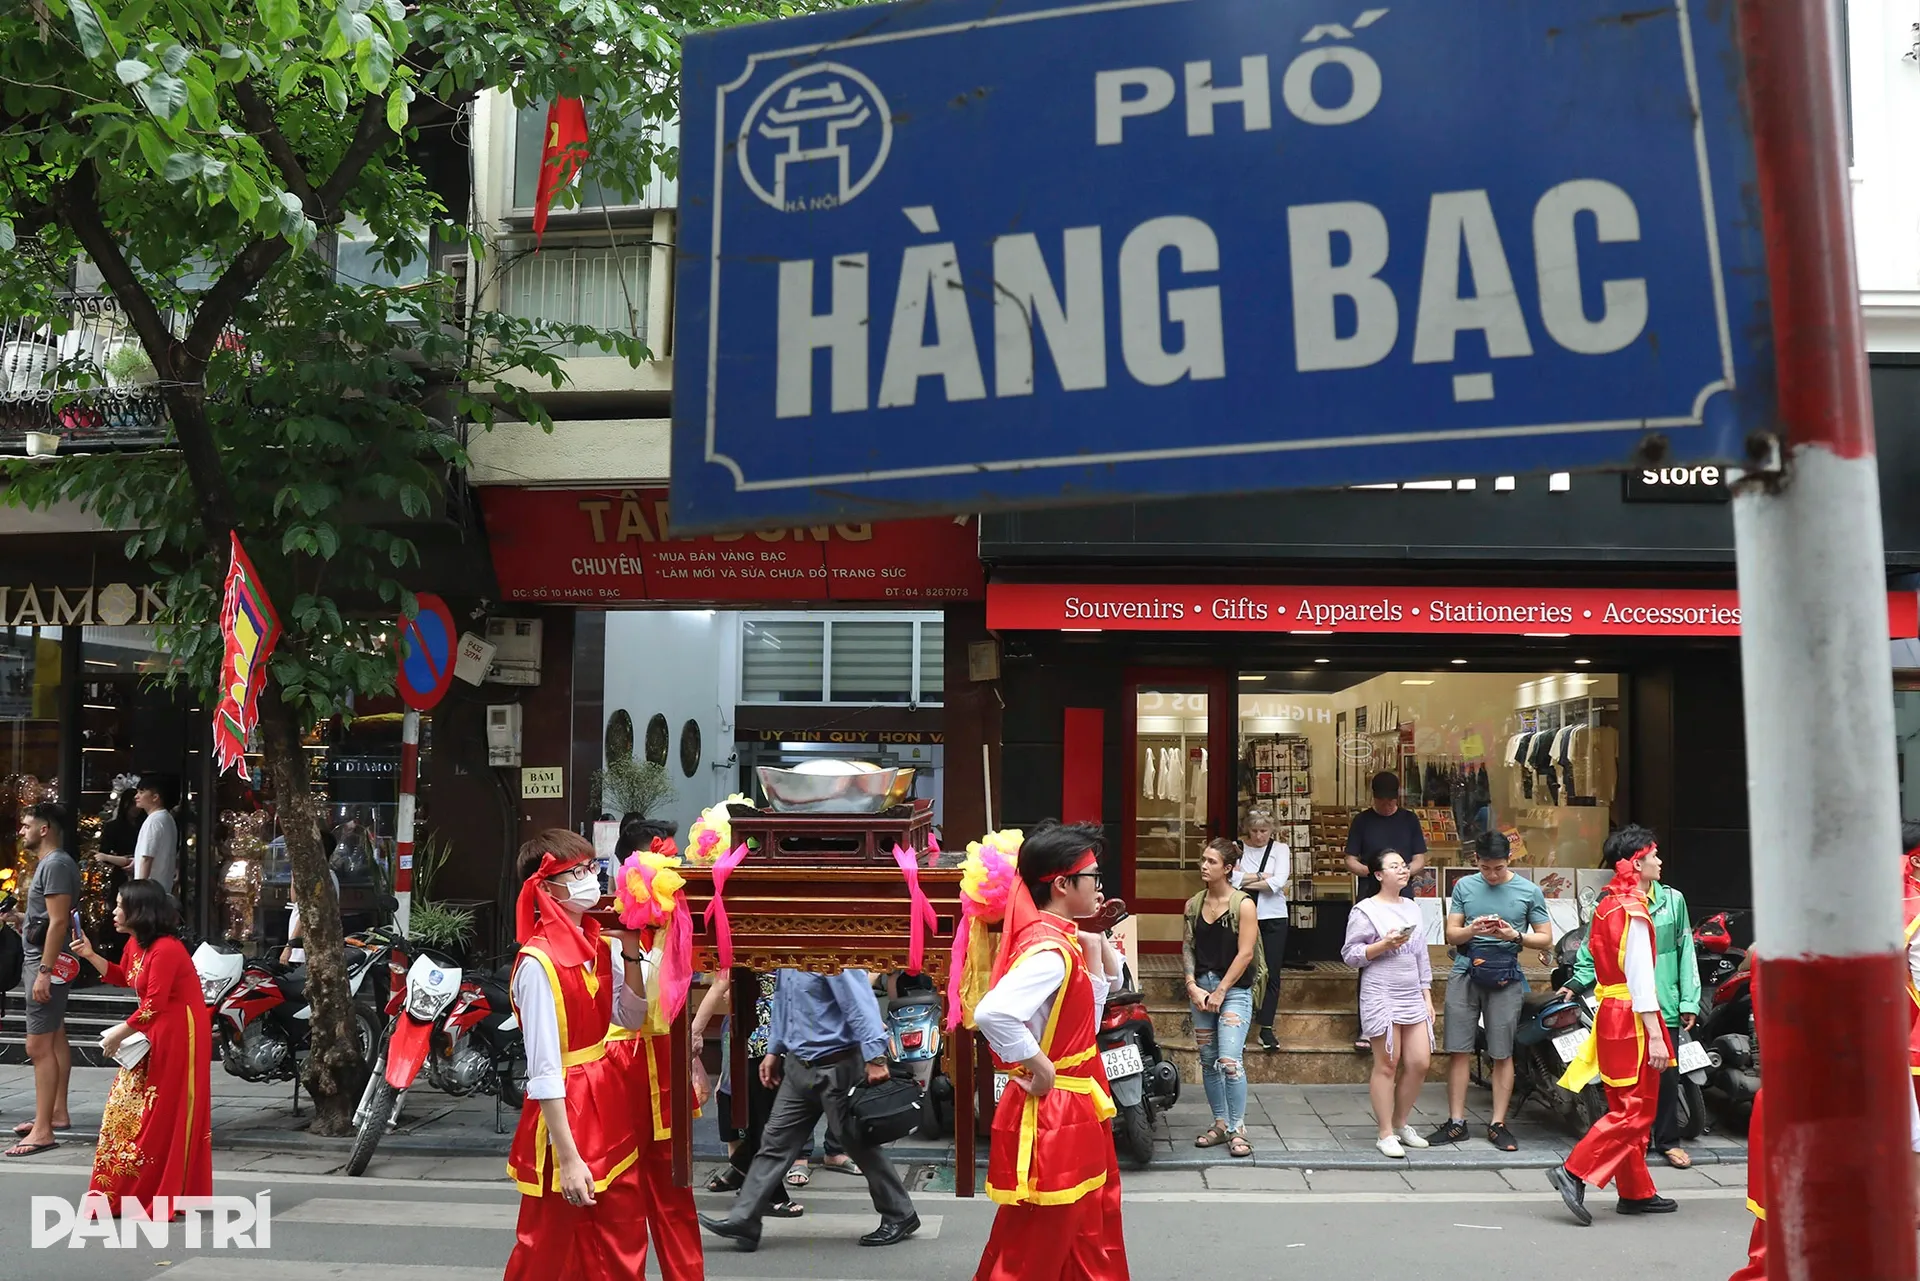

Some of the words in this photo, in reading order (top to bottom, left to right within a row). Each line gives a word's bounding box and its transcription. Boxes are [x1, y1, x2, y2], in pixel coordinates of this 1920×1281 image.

[1093, 7, 1389, 146] PHỐ
[775, 205, 1227, 418] HÀNG
[1286, 178, 1650, 402] BẠC
[571, 553, 643, 576] CHUYÊN
[689, 549, 716, 562] BÁN
[720, 549, 755, 562] VÀNG
[760, 551, 787, 564] BẠC
[720, 566, 737, 578] VÀ
[832, 568, 876, 578] TRANG
[881, 566, 907, 578] SỨC
[551, 588, 561, 598] 10
[1064, 597, 1184, 620] Souvenirs
[1212, 598, 1268, 621] Gifts
[1296, 599, 1403, 626] Apparels
[1429, 601, 1572, 624] Stationeries
[1602, 602, 1743, 625] Accessories
[541, 785, 560, 794] TAI
